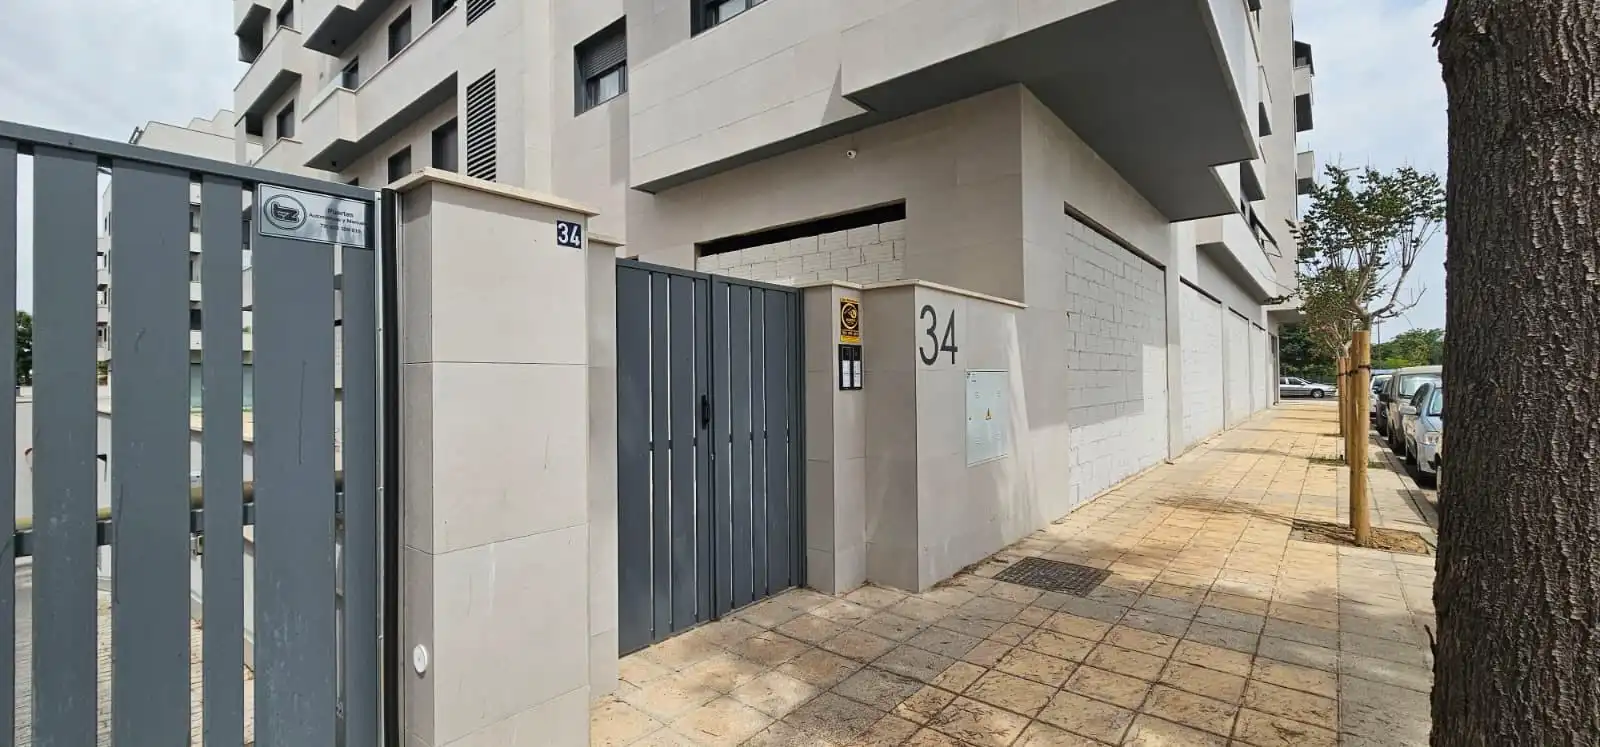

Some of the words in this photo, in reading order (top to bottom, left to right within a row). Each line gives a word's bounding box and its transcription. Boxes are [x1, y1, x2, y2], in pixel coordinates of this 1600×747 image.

[327, 208, 354, 218] Puertas
[558, 222, 580, 246] 34
[919, 304, 958, 366] 34
